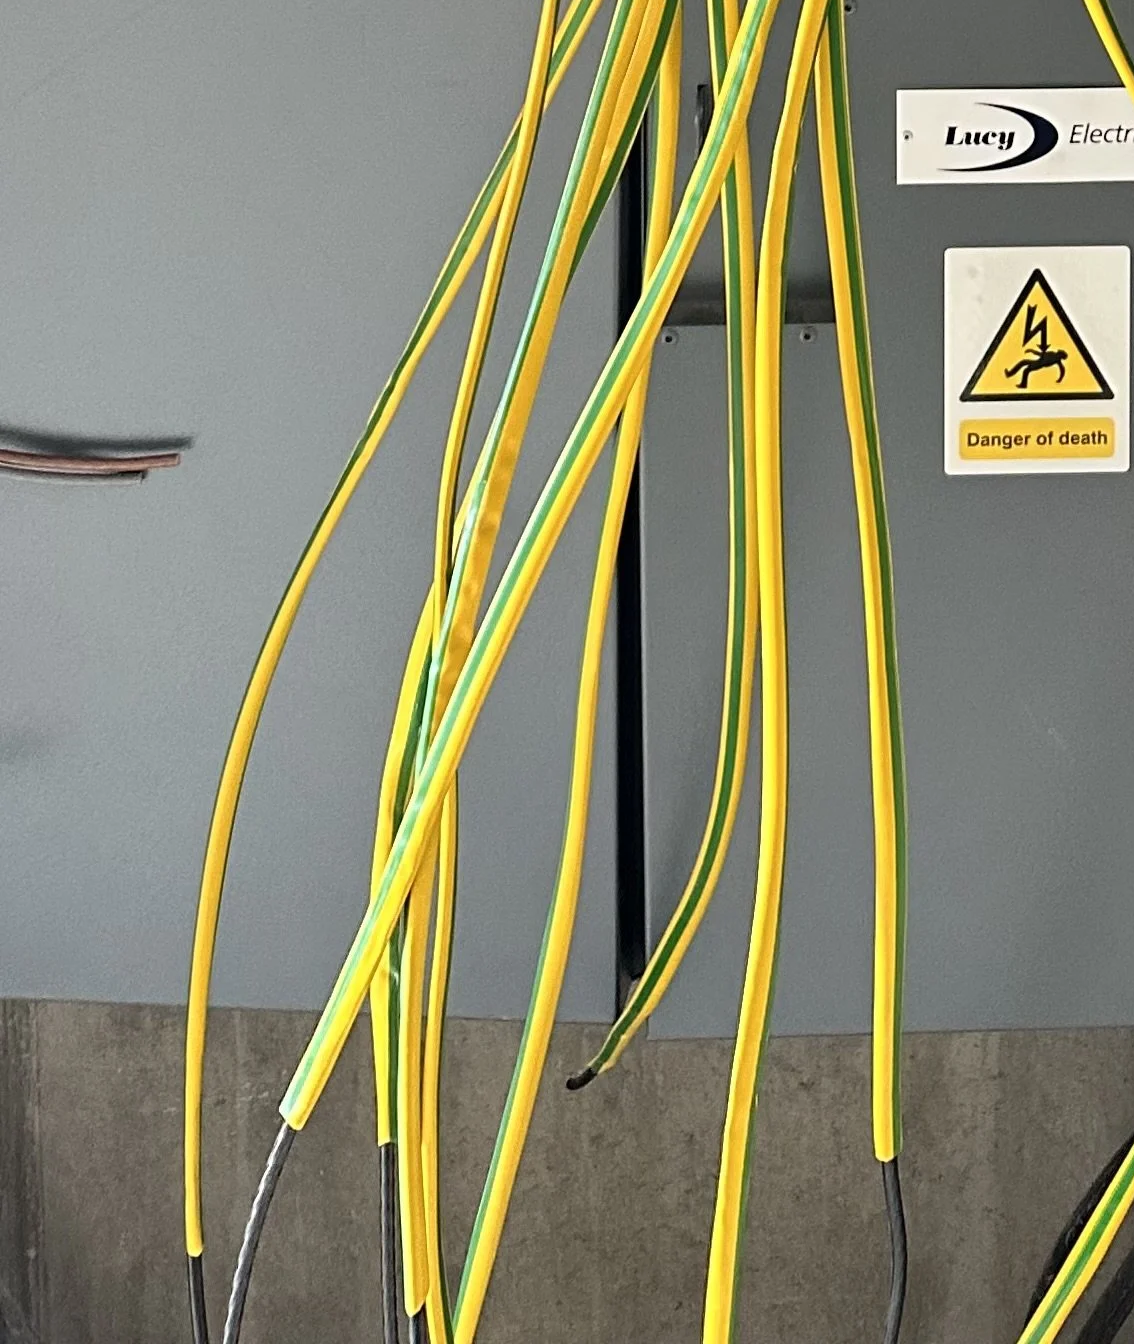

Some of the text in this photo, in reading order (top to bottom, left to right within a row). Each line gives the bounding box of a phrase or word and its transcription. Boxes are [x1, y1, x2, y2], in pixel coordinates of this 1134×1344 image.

[945, 125, 1016, 151] Lucy
[966, 430, 1108, 450] Danger of death
